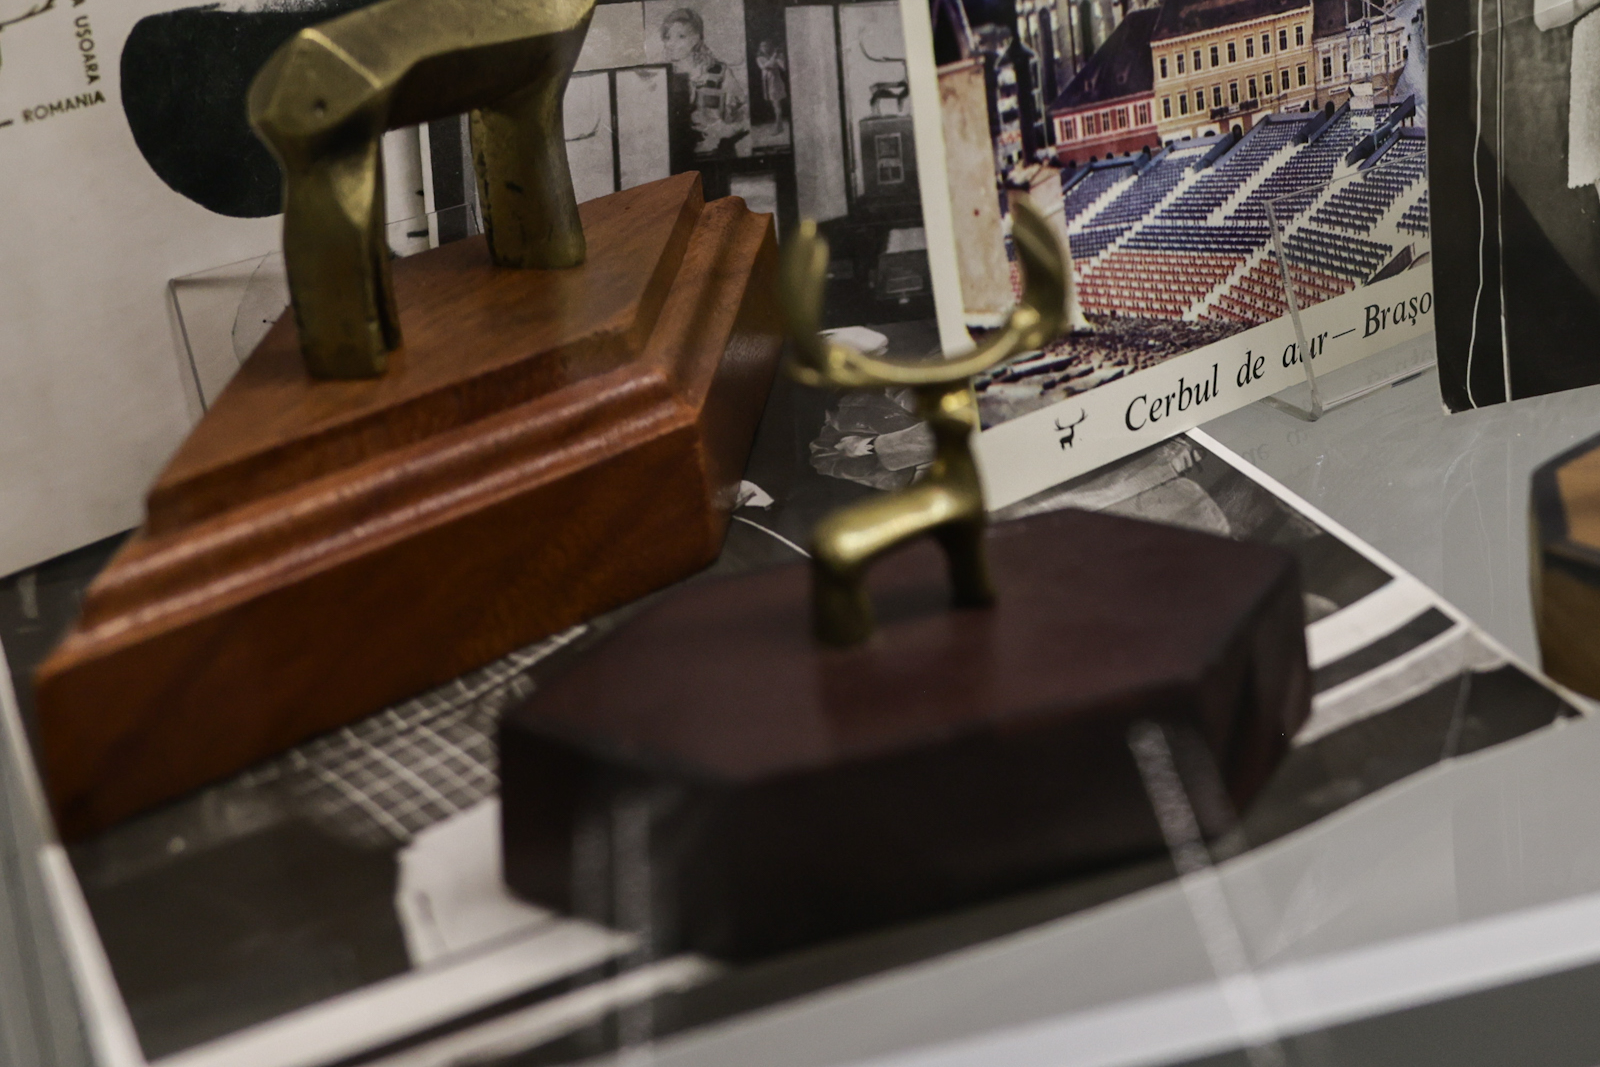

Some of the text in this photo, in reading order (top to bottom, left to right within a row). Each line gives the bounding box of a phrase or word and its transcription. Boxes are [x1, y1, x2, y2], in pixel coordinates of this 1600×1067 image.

[22, 90, 106, 123] ROMANIA
[1124, 363, 1219, 431] Cerbul
[1236, 350, 1266, 388] de
[1362, 292, 1433, 339] Brașo
